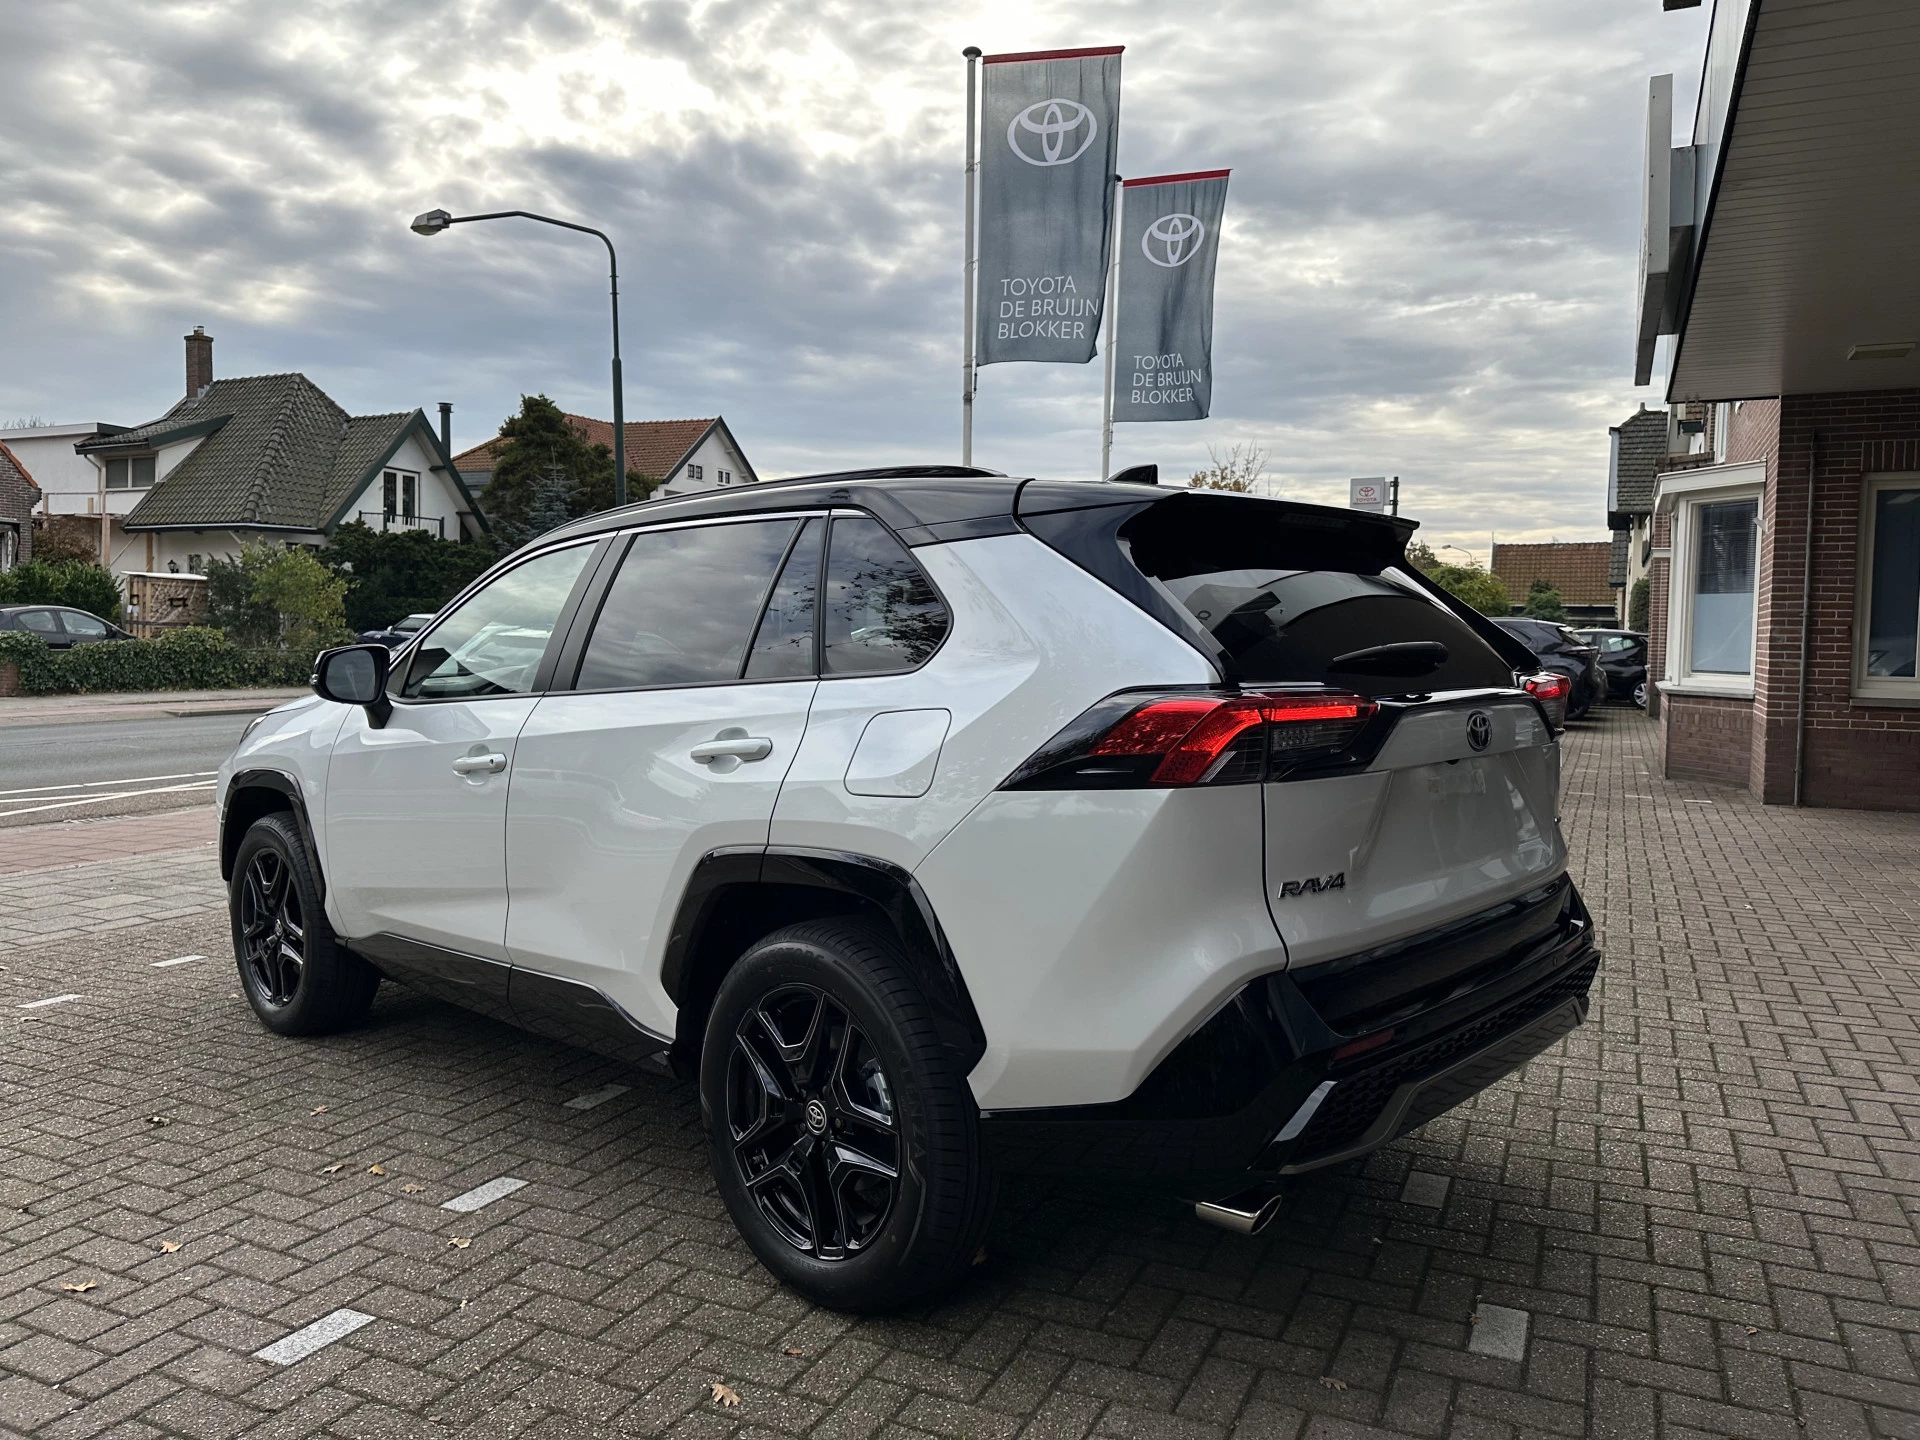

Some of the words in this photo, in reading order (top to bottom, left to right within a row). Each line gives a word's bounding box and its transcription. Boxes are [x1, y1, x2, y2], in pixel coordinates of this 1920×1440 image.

[1000, 275, 1077, 297] TOYOTA
[1000, 300, 1025, 318] DE
[1031, 298, 1099, 317] BRUIJN
[998, 320, 1085, 340] BLOKKER
[1133, 352, 1185, 370] TOYOTA
[1133, 372, 1154, 387] DE
[1157, 368, 1202, 387] BRUIJN
[1131, 387, 1195, 404] BLOKKER
[1277, 871, 1346, 899] RAV4
